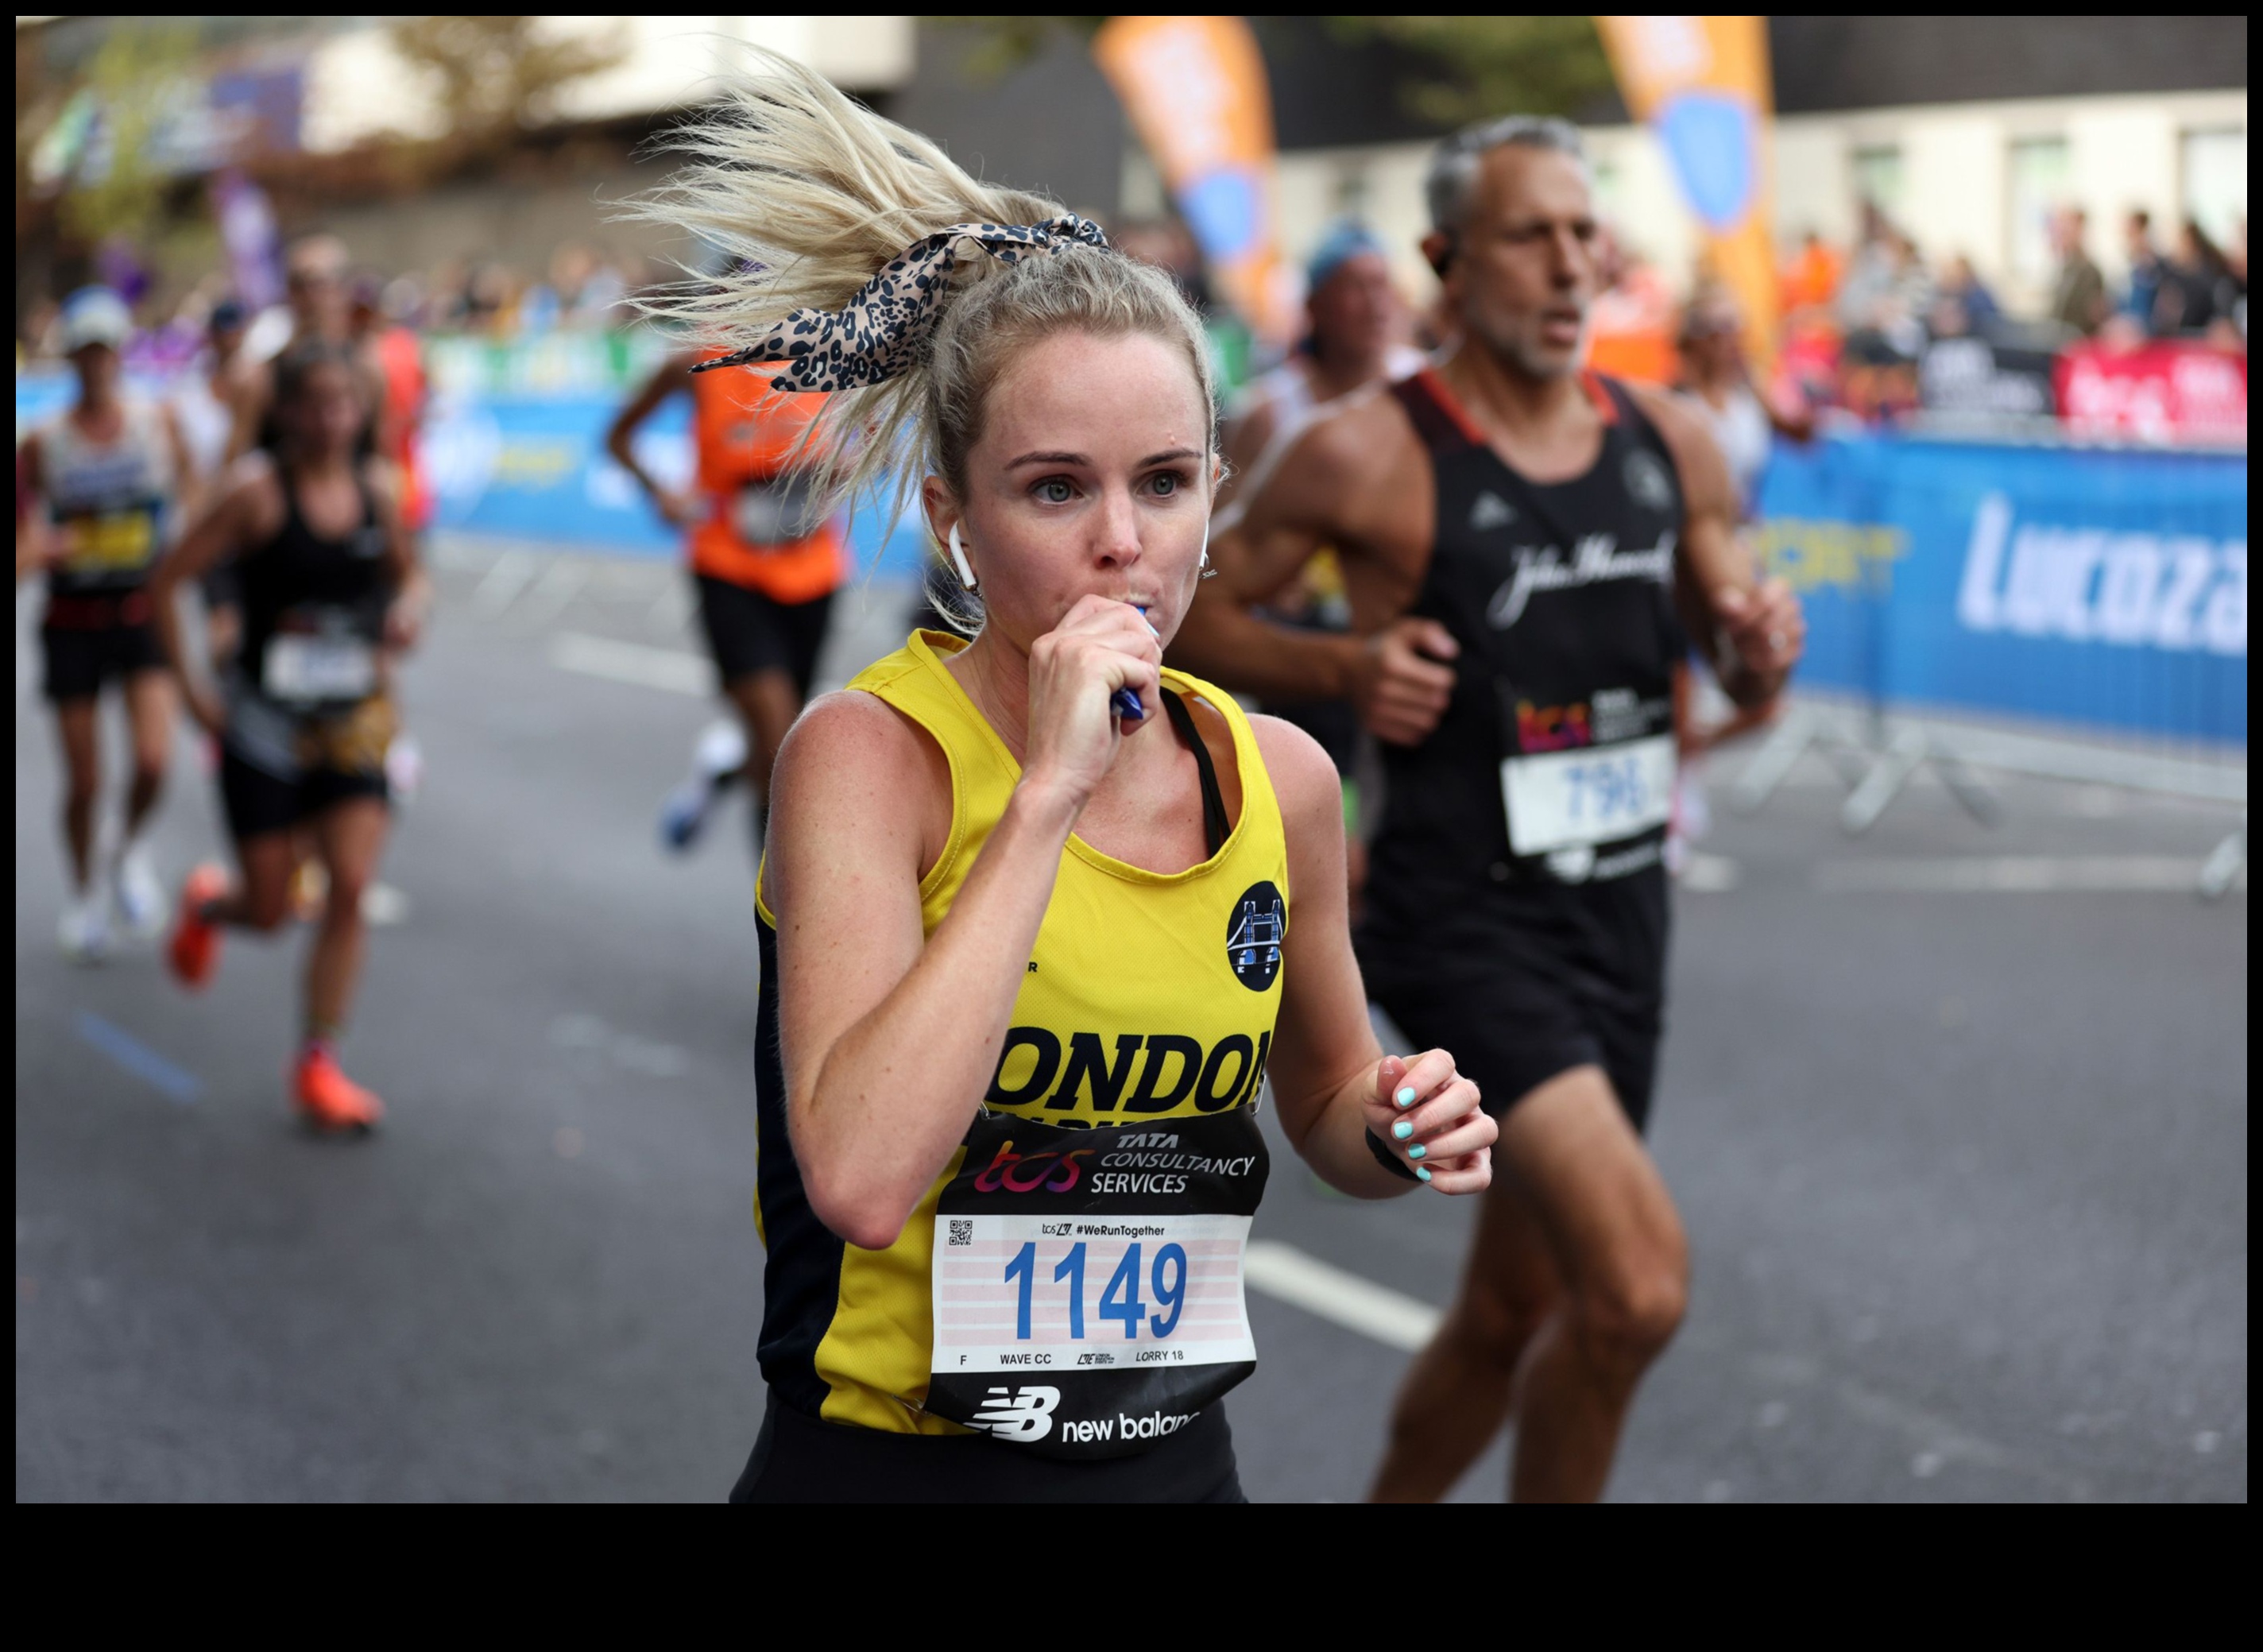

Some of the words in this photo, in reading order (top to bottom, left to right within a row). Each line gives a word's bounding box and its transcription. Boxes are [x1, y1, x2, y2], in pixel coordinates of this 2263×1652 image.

[985, 1026, 1271, 1113] ONDO
[1116, 1133, 1179, 1149] TATA
[974, 1140, 1096, 1193] tcs
[1101, 1152, 1255, 1176] CONSULTANCY
[1091, 1173, 1190, 1194] SERVICES
[1076, 1224, 1165, 1238] #WeRunTogether
[1004, 1242, 1187, 1340] 1149
[960, 1355, 967, 1365] F
[1000, 1353, 1032, 1364] WAVE
[1034, 1353, 1052, 1364] CC
[1135, 1350, 1169, 1362] LORRY
[1171, 1350, 1184, 1360] 18
[1062, 1419, 1113, 1442] new
